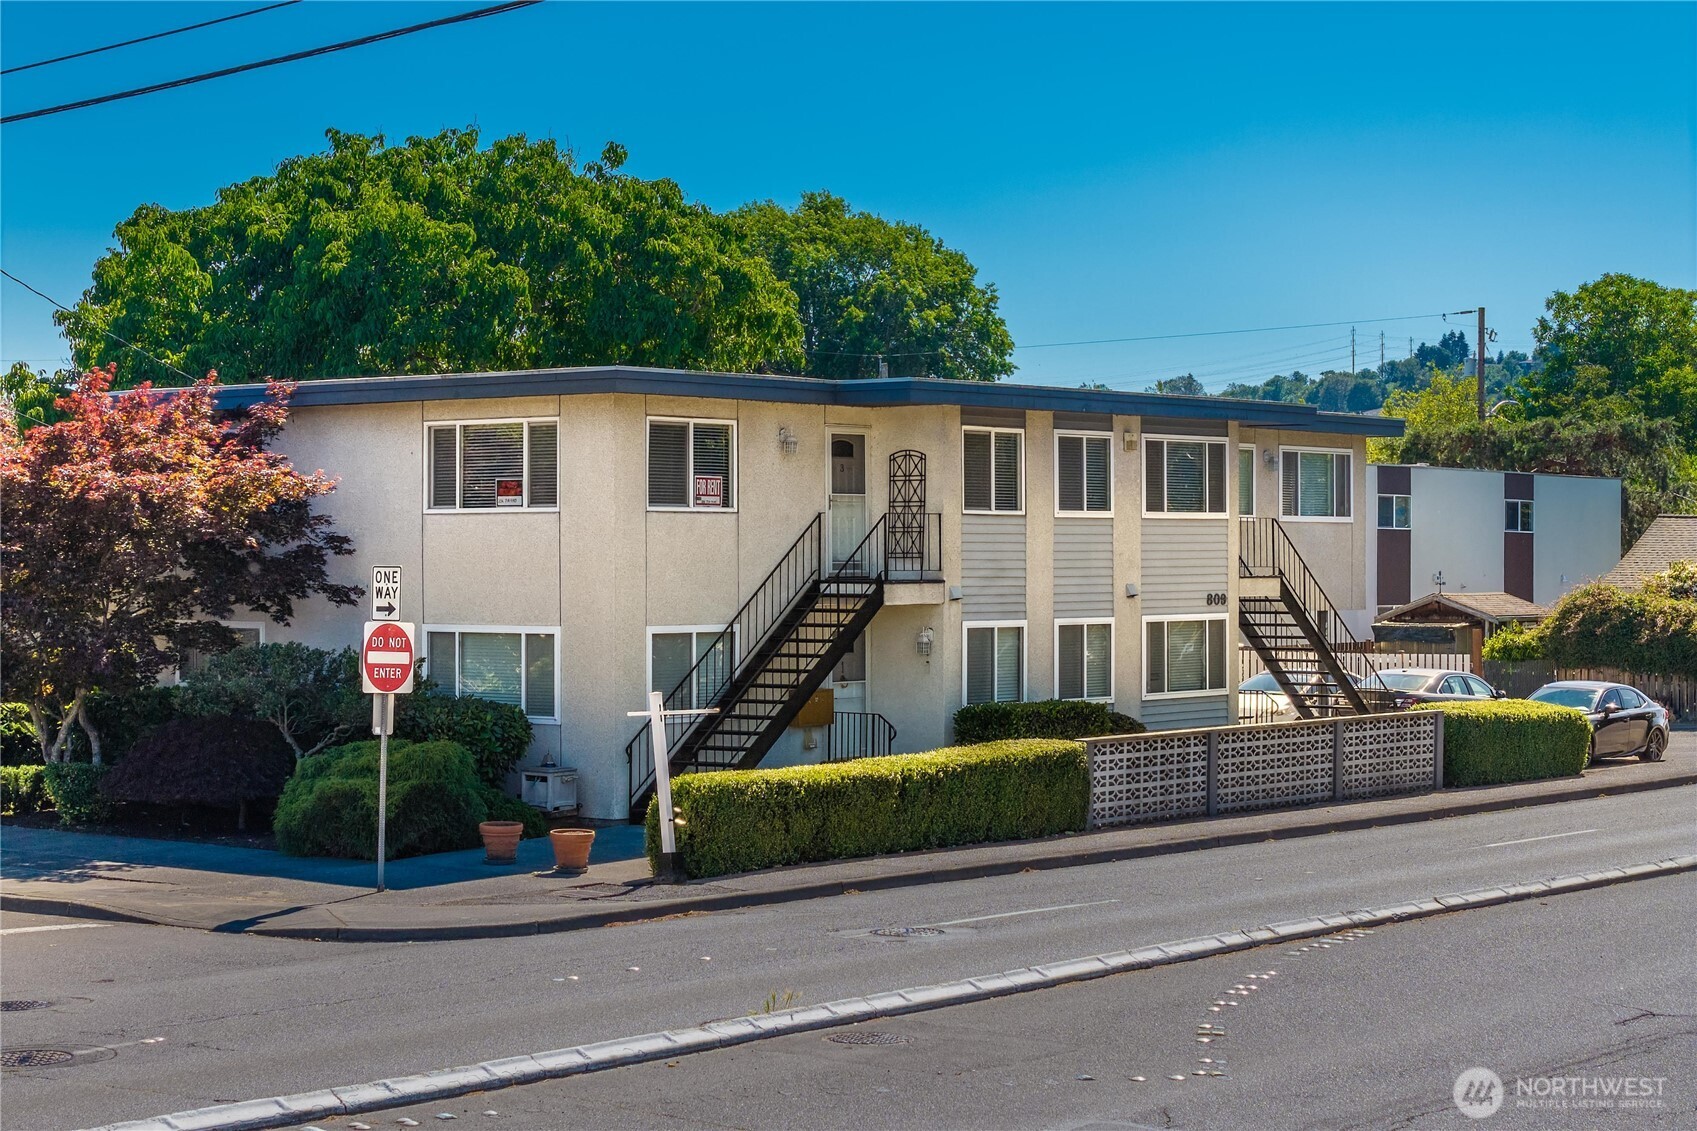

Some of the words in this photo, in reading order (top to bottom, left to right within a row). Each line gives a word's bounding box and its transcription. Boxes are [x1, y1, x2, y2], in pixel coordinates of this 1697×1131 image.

[840, 464, 844, 472] 3
[696, 479, 706, 495] FOR
[707, 479, 720, 495] RENT
[375, 571, 398, 584] ONE
[375, 586, 398, 599] WAY
[371, 636, 384, 648] DO
[389, 637, 407, 649] NOT
[373, 667, 402, 679] ENTER
